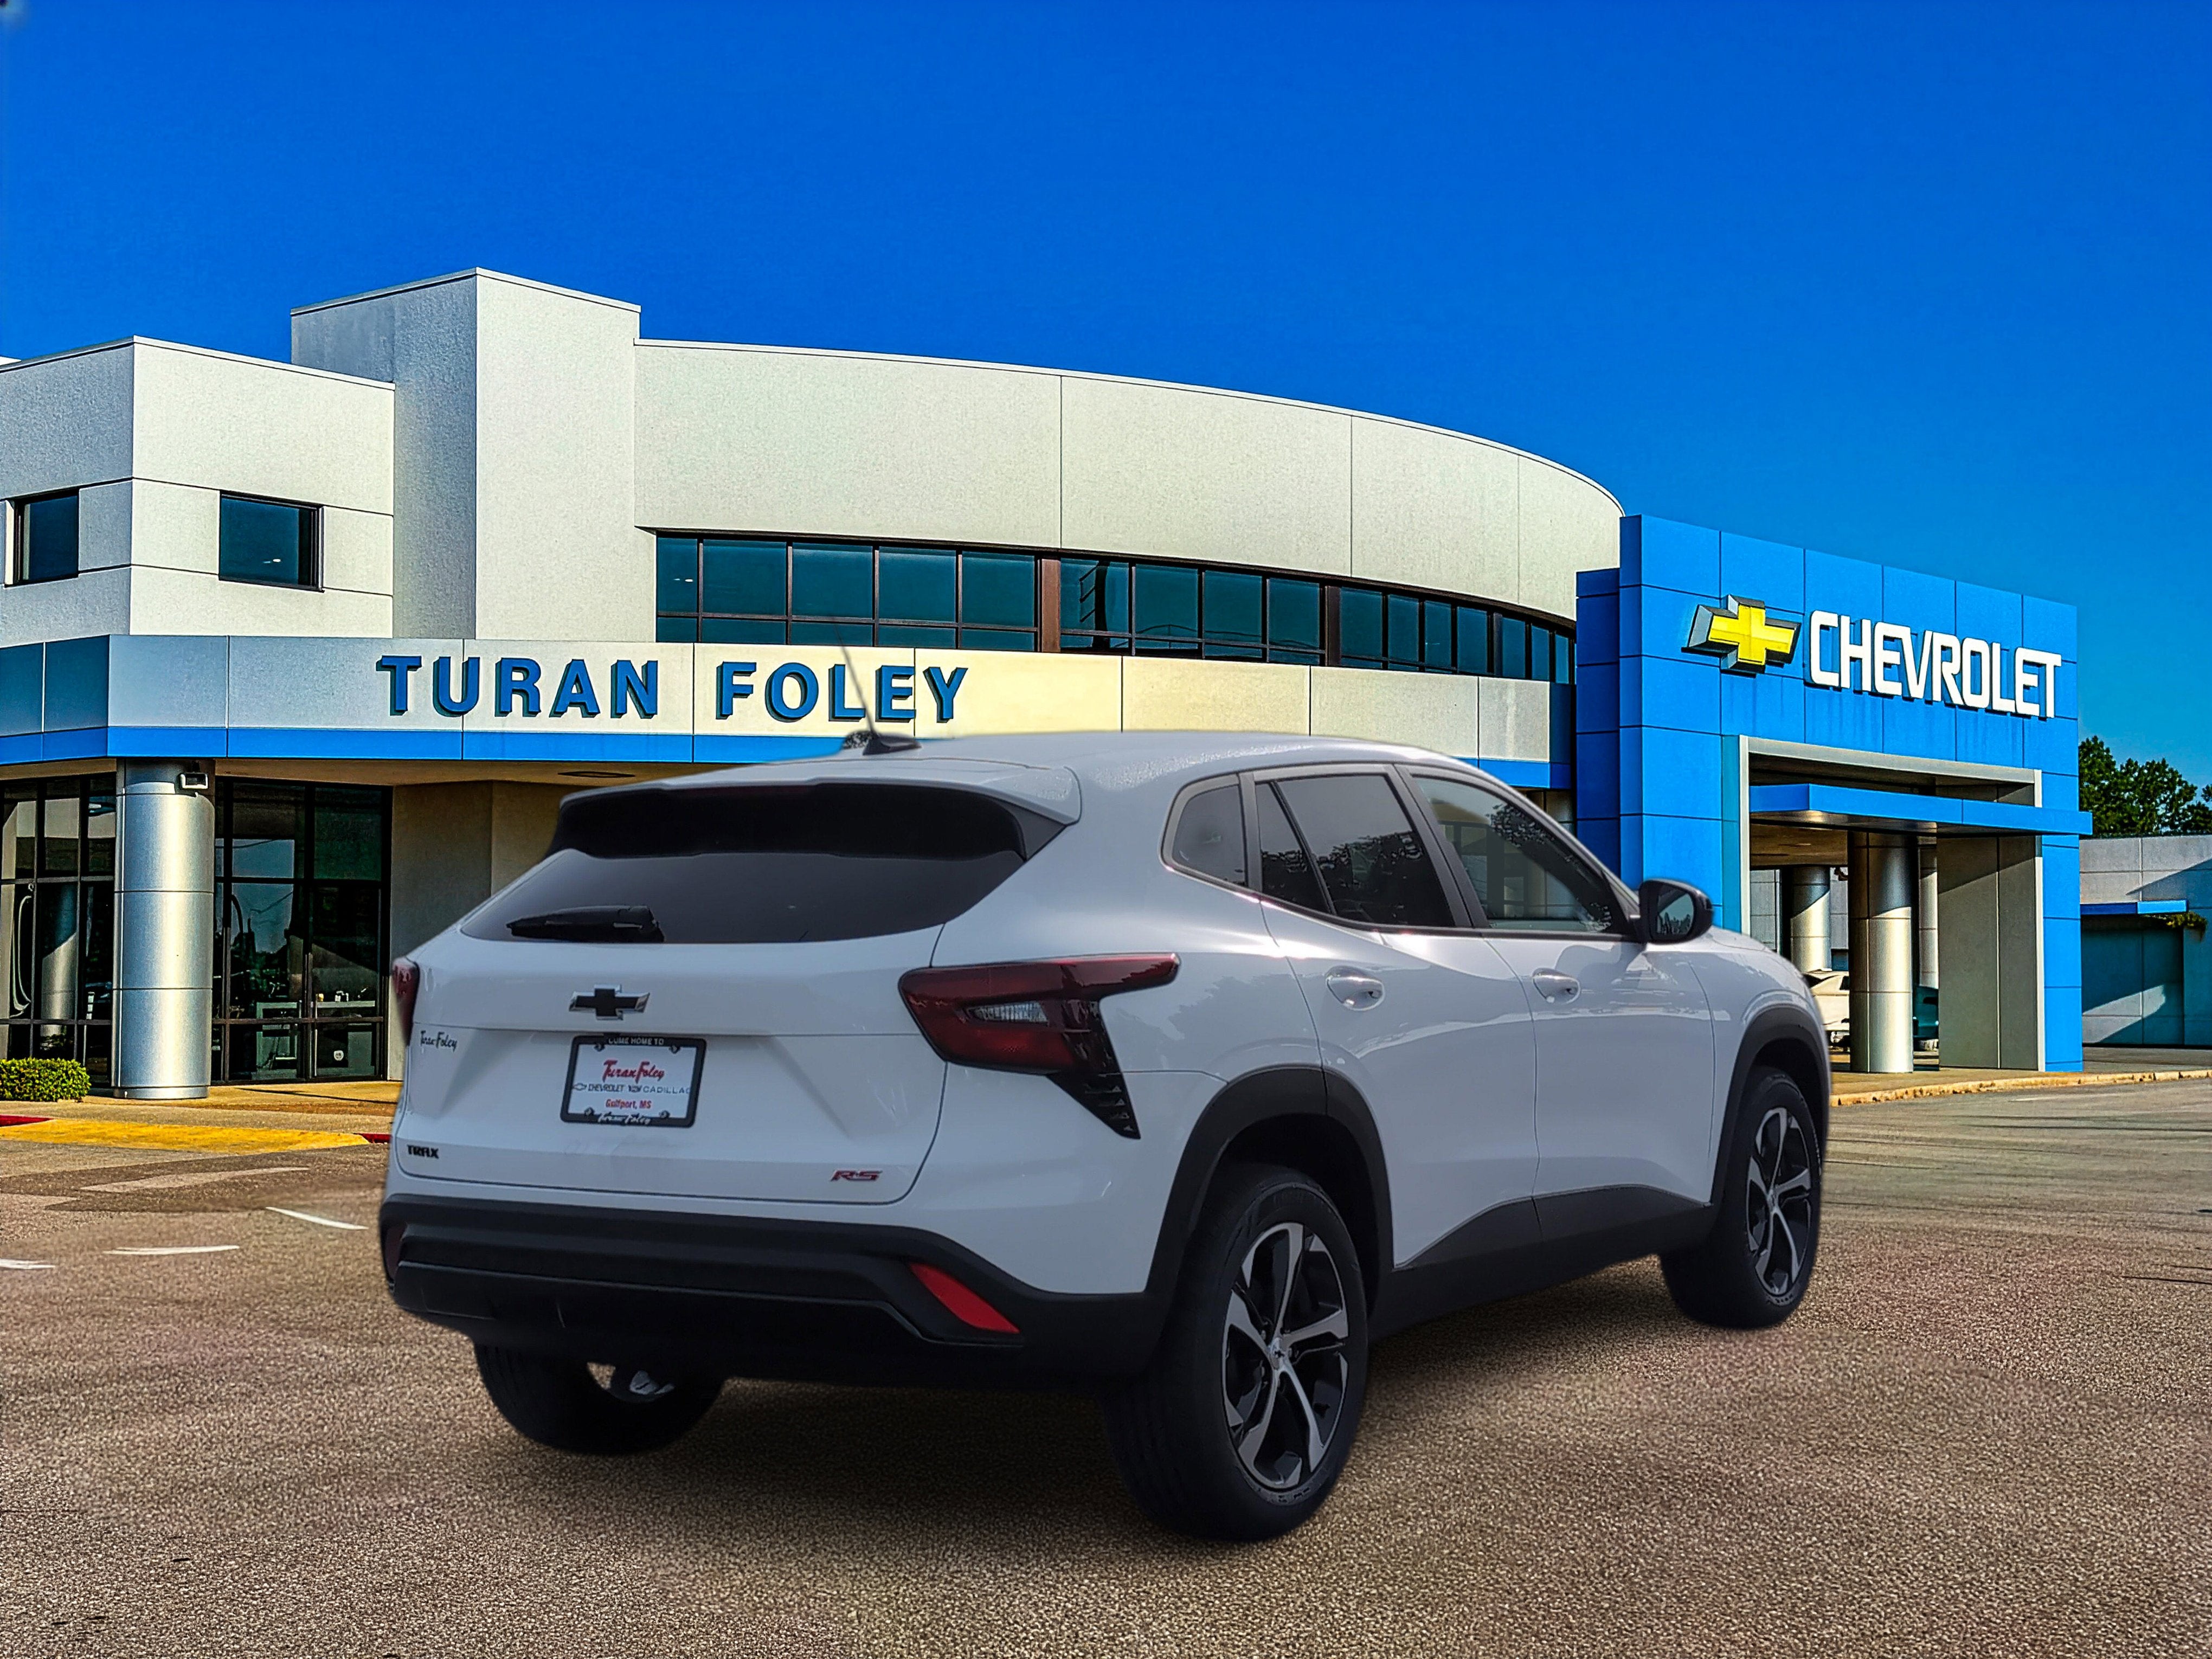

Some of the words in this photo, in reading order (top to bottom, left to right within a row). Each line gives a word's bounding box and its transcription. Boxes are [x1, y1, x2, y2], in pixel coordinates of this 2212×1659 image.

[1810, 610, 2062, 718] CHEVROLET
[376, 655, 658, 719] TURAN
[716, 661, 968, 724] FOLEY
[606, 1099, 637, 1109] Gulfport,
[639, 1100, 652, 1109] MS
[407, 1144, 439, 1159] TRAX
[830, 1170, 883, 1182] RS
